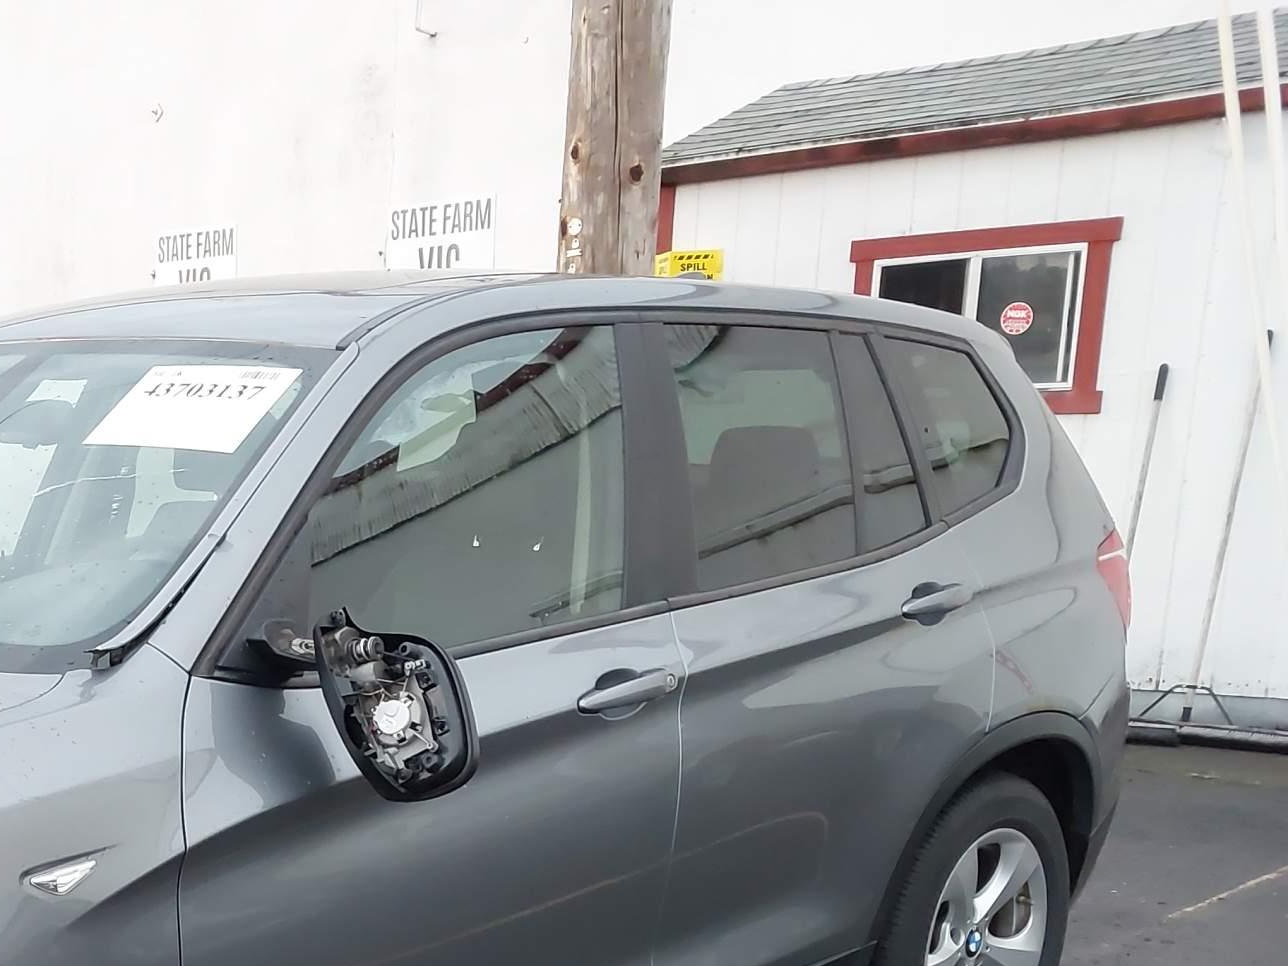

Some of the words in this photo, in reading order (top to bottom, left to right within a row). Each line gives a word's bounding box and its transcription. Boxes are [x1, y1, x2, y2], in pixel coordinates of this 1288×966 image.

[392, 206, 438, 241] STATE
[443, 198, 492, 235] FARM
[158, 233, 192, 263] STATE
[197, 228, 234, 260] FARM
[680, 262, 707, 272] SPILL
[144, 382, 267, 400] 43703137
